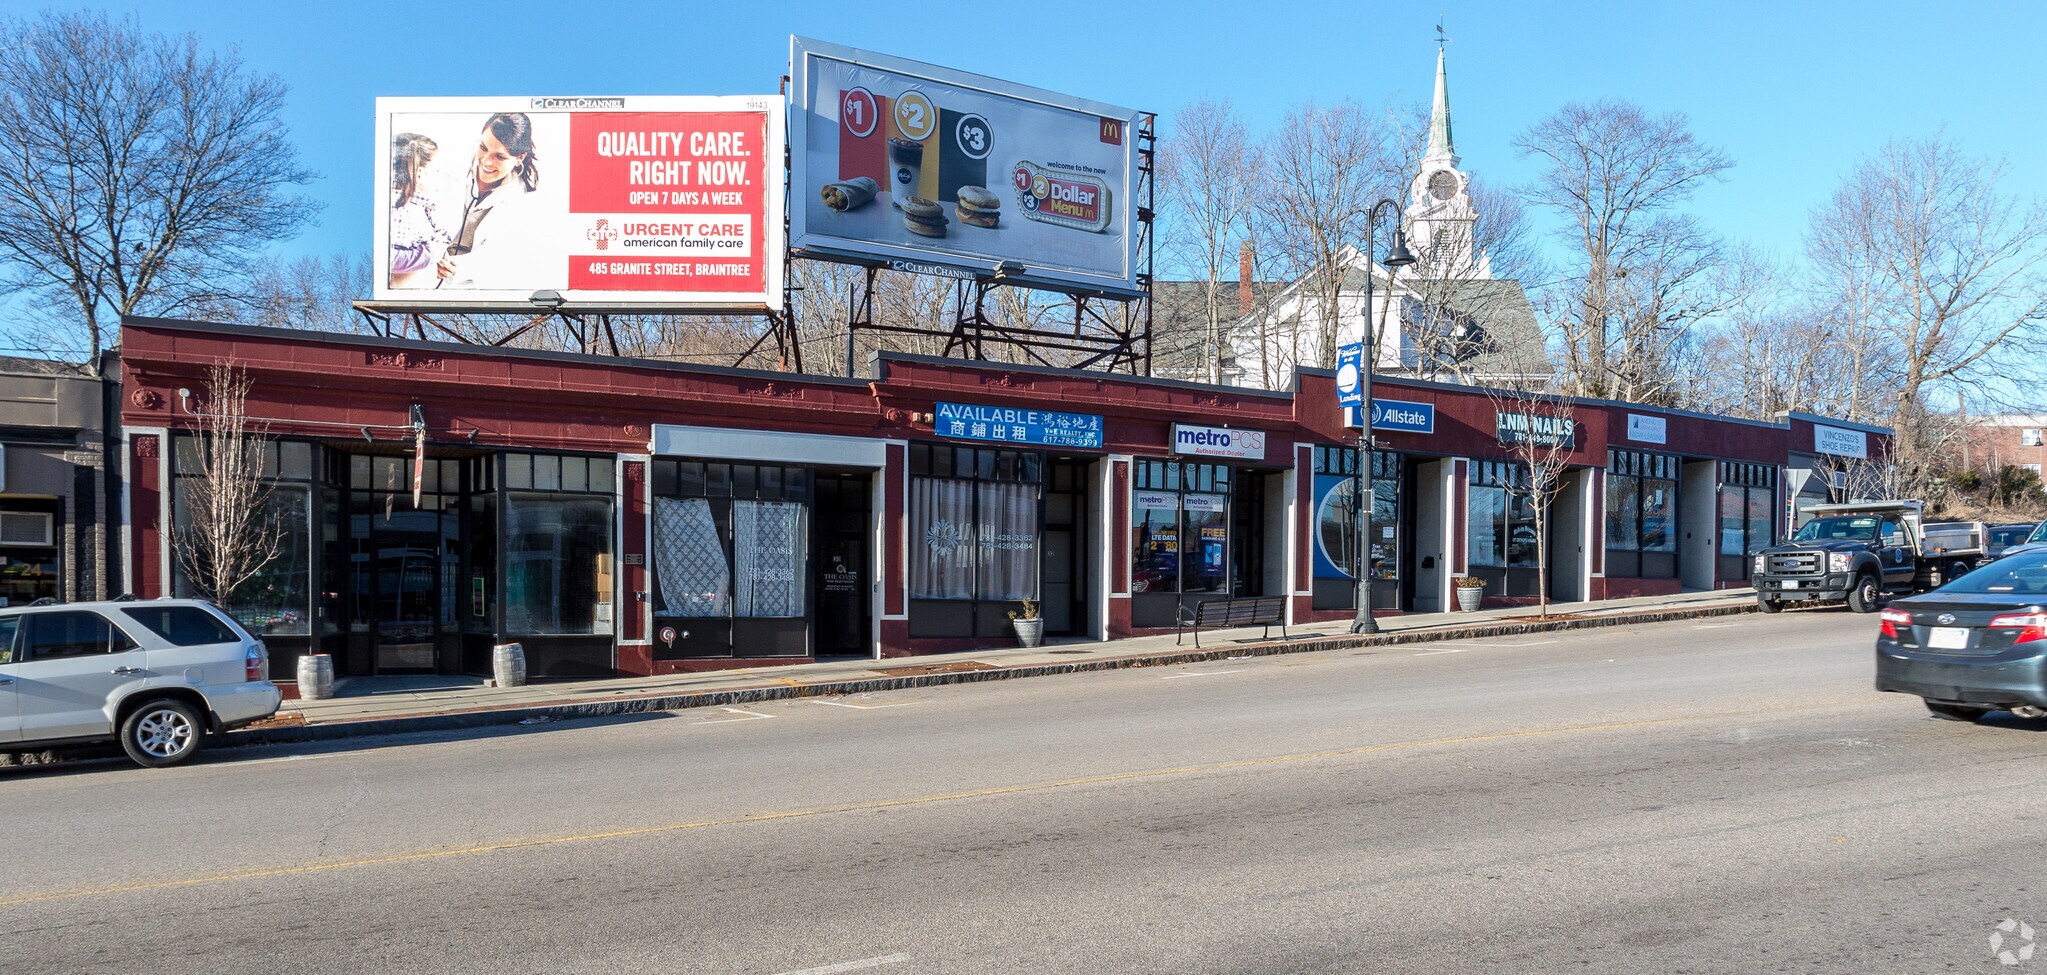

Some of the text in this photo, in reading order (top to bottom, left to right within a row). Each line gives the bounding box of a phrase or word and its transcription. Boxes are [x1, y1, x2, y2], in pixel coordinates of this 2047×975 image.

[847, 99, 863, 125] $1
[901, 102, 925, 129] $2
[597, 131, 751, 157] QUALITY CARE.
[963, 125, 985, 150] $3
[630, 161, 751, 185] RIGHT NOW.
[1046, 161, 1075, 171] welcome
[1016, 173, 1026, 186] $1
[1033, 181, 1045, 194] $2
[1051, 183, 1095, 205] Dollar
[629, 191, 743, 205] OPEN 7 DAYS A WEEK
[1023, 194, 1035, 208] $3
[1051, 199, 1083, 217] Menu
[623, 223, 744, 236] URGENT CARE
[623, 237, 744, 250] american family care
[589, 262, 750, 277] 485 GRANITE STREET, BRAINTREE
[939, 404, 1038, 425] AVAILABLE
[1382, 409, 1426, 425] Allstate
[950, 421, 1027, 440] 商鋪出租
[1532, 415, 1573, 436] NAILS
[1043, 435, 1098, 446] 617-786-9399
[1514, 432, 1558, 444] 781-49-800
[1823, 430, 1859, 444] VINCENZO'S
[1195, 447, 1226, 456] Authorized
[1821, 440, 1839, 451] SHOE
[1201, 527, 1226, 537] FREE
[768, 546, 793, 555] OASIS
[1150, 541, 1157, 550] 2
[21, 563, 42, 576] 24
